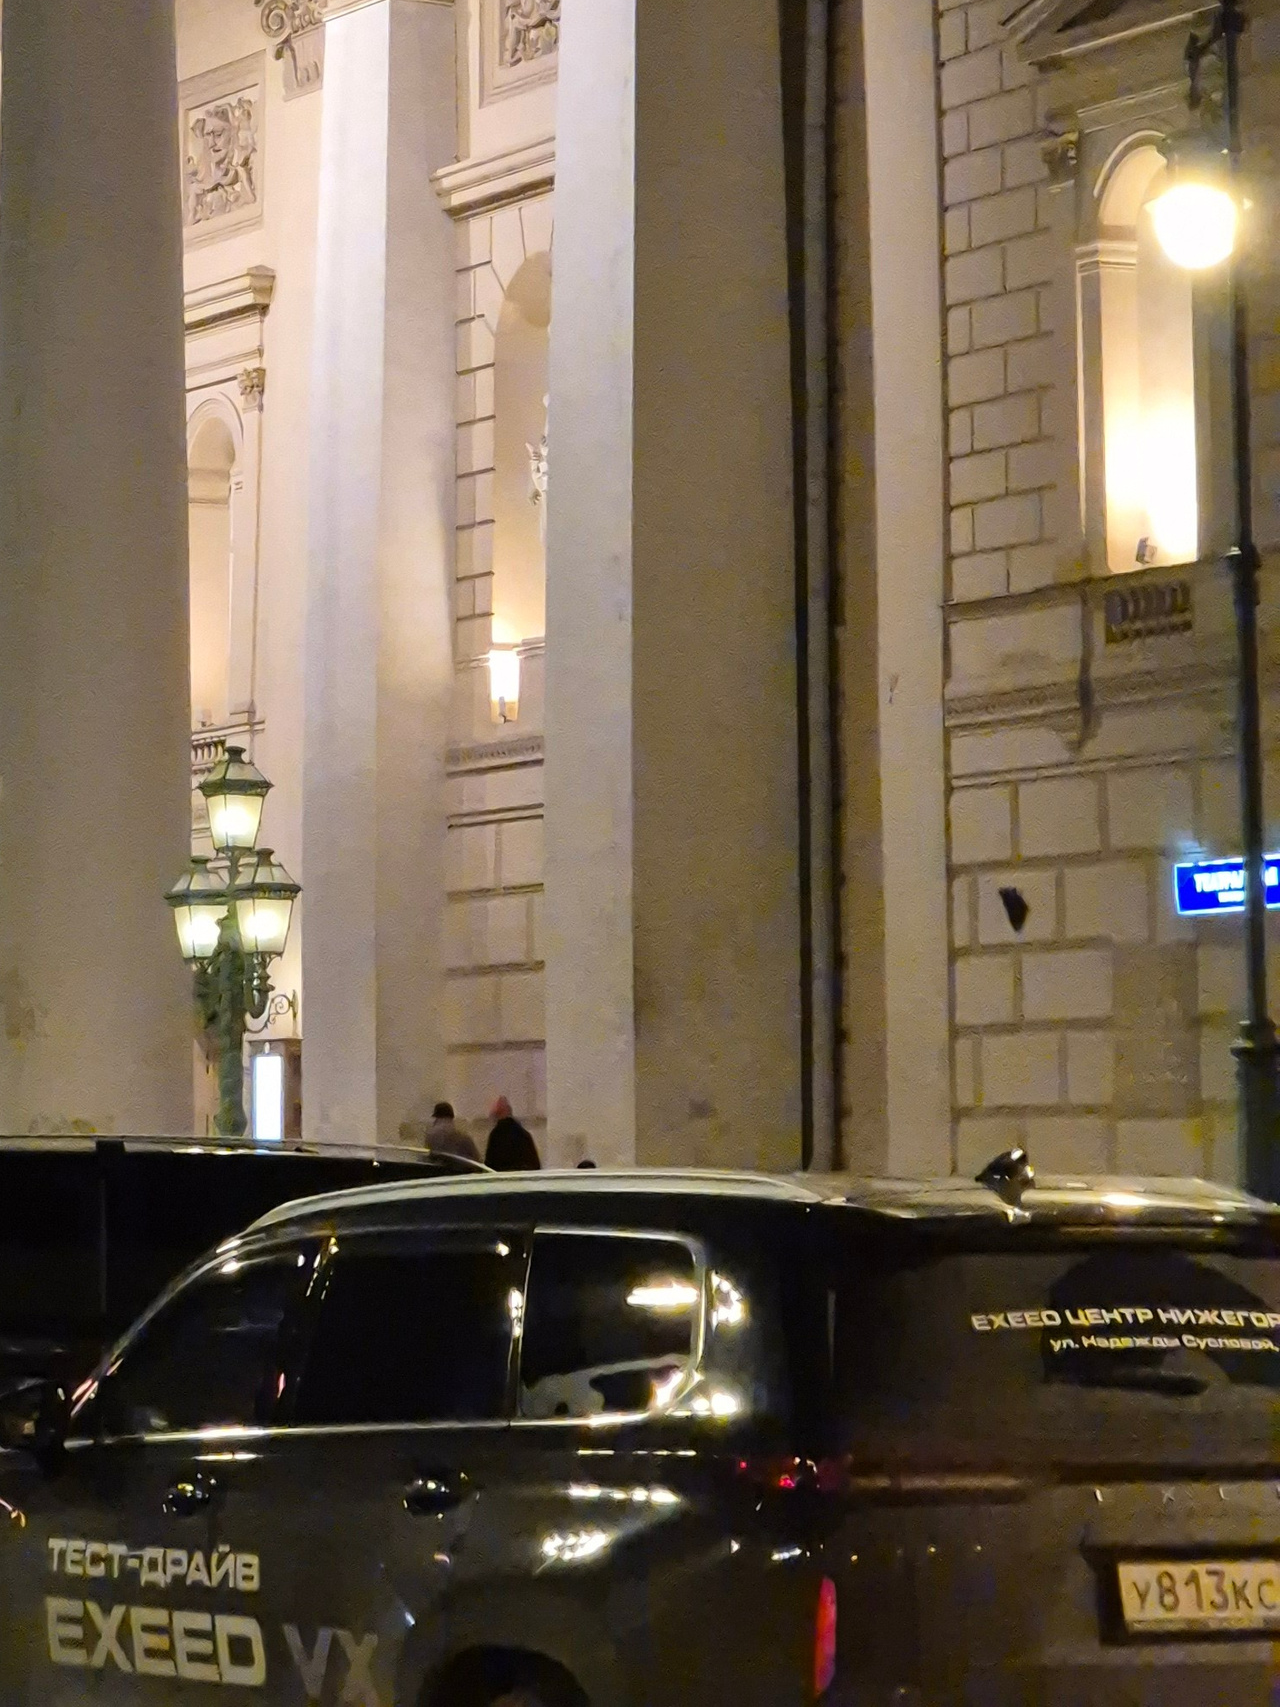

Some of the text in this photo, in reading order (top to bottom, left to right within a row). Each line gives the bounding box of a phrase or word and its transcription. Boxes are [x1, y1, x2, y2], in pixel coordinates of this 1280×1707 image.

[971, 1309, 1062, 1331] EXEED
[1064, 1307, 1154, 1327] ЦЕНТР
[1049, 1338, 1080, 1352] ул.
[1081, 1335, 1181, 1350] Надежды
[48, 1537, 261, 1593] ТЕСТ-ДРАЙВ
[44, 1595, 267, 1687] EXEED
